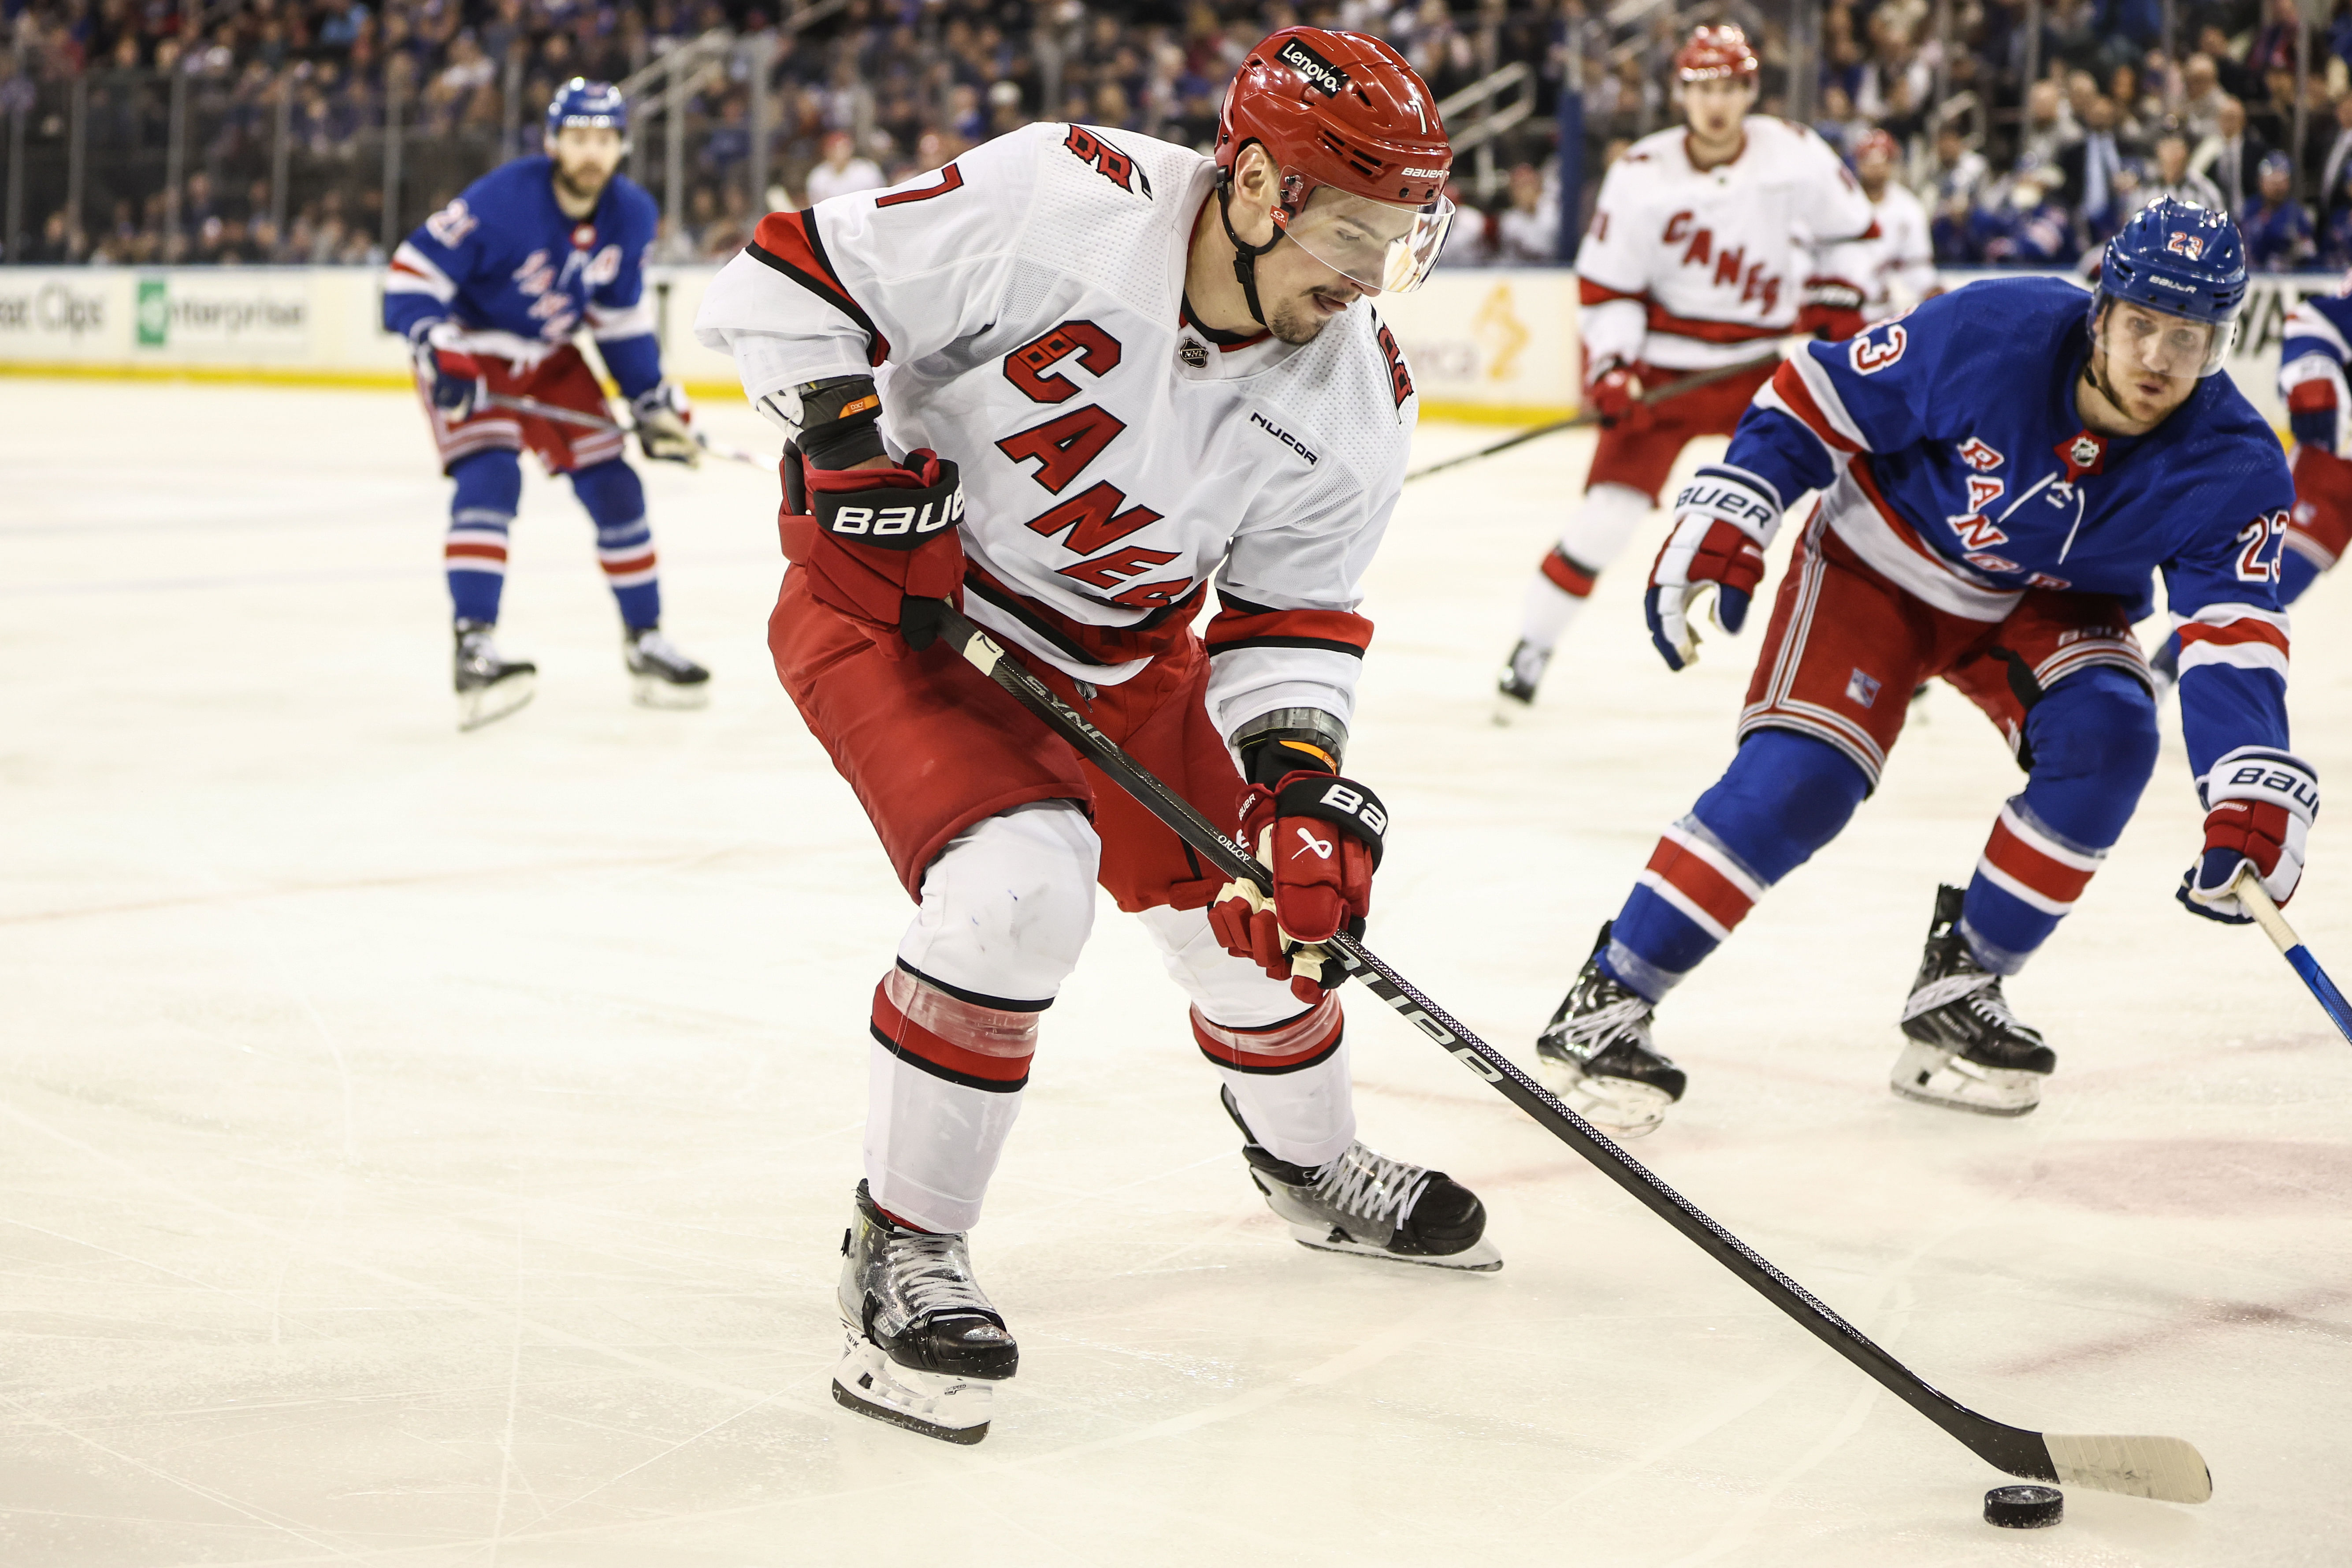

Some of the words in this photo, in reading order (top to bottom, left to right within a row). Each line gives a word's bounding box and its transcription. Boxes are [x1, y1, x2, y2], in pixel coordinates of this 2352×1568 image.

[1282, 43, 1337, 90] Lenovo
[1408, 99, 1427, 134] 7
[875, 162, 965, 208] 7
[1401, 167, 1444, 178] BAUER
[1661, 210, 1781, 316] CANES
[2167, 231, 2203, 261] 23
[1250, 411, 1318, 466] NUCOR
[2235, 510, 2290, 584] 23
[1218, 835, 1252, 861] ORLOV
